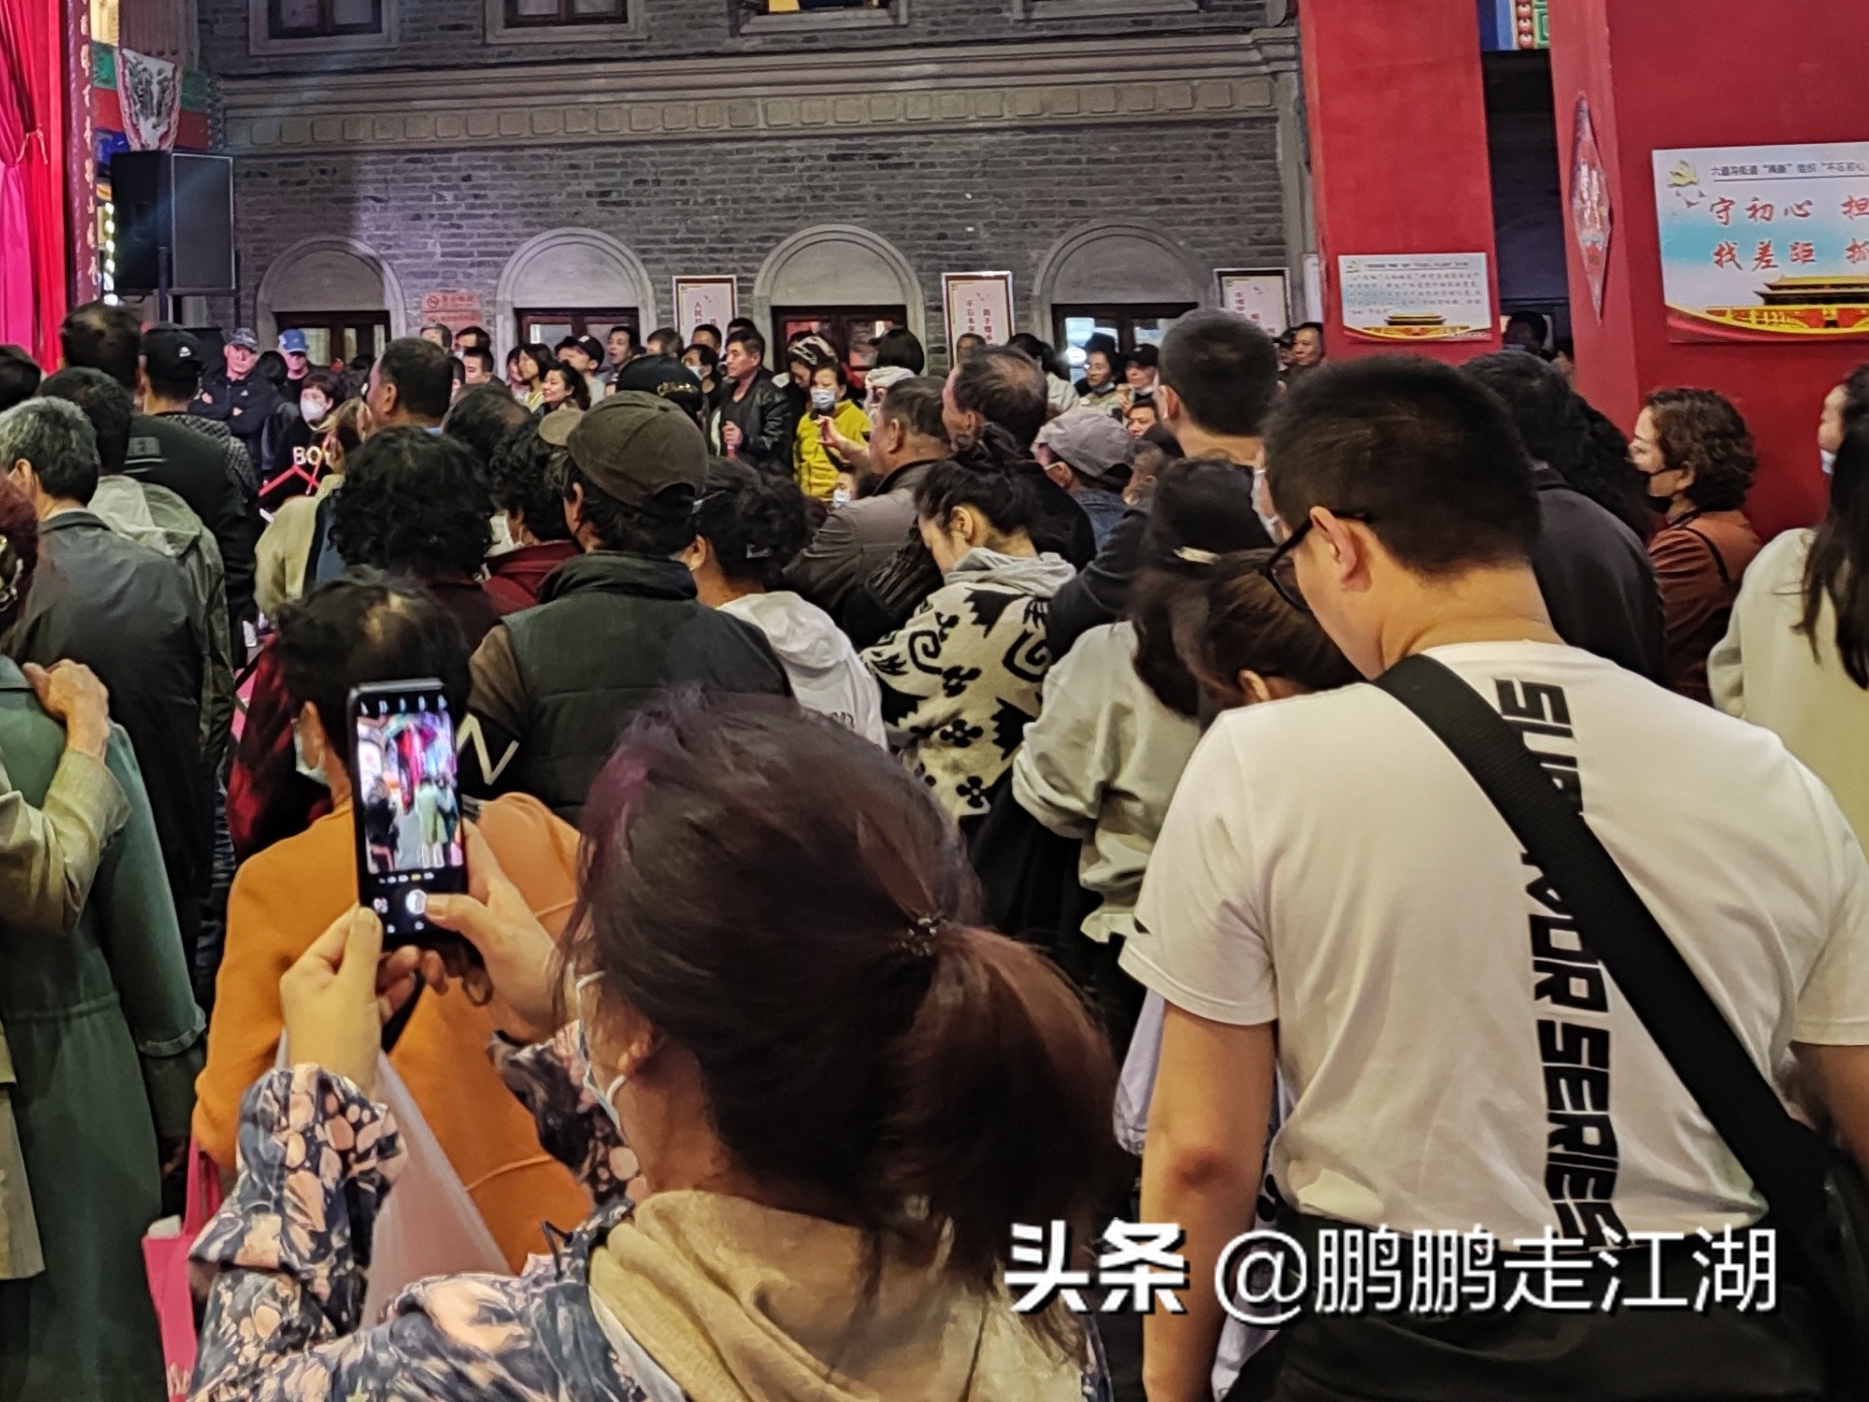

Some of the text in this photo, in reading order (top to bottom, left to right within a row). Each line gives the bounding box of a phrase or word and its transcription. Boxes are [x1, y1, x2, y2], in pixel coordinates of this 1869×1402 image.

[1710, 197, 1813, 225] 守初心
[1713, 240, 1817, 271] 找差距
[1495, 678, 1631, 1248] SUOR SERIES
